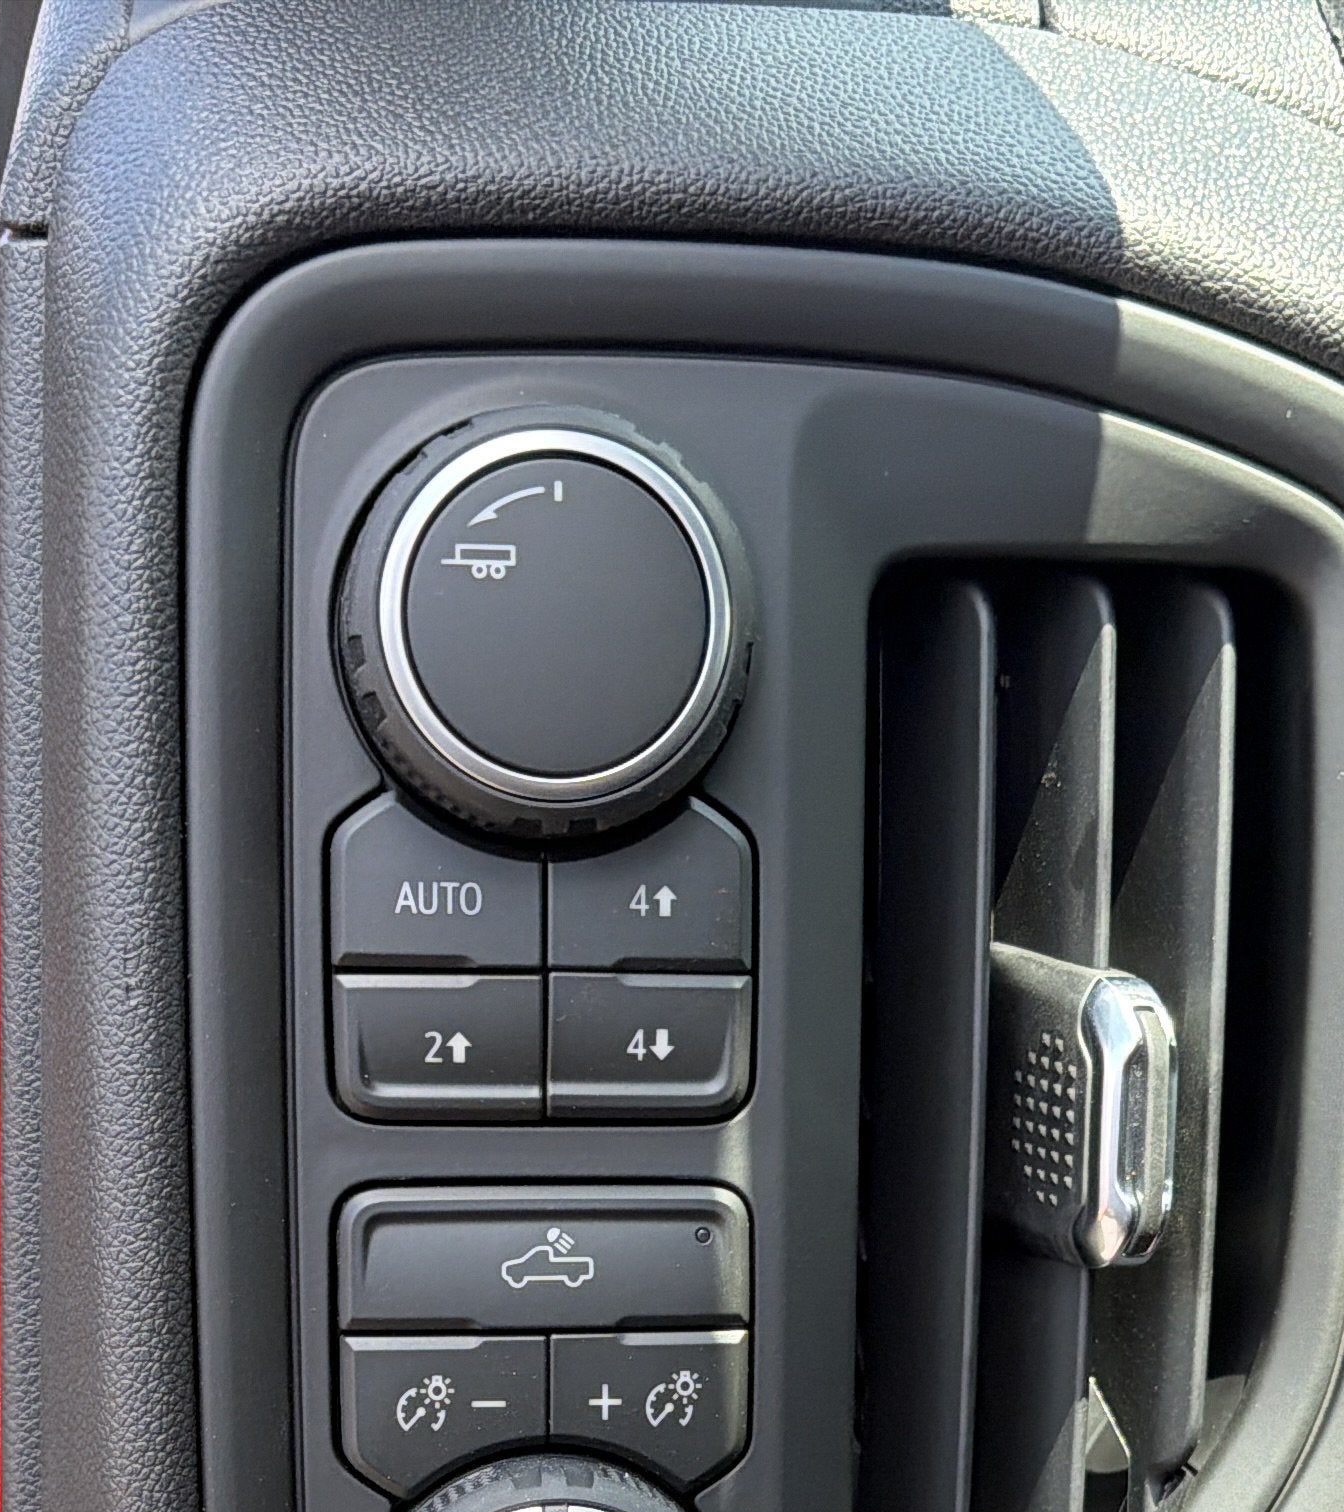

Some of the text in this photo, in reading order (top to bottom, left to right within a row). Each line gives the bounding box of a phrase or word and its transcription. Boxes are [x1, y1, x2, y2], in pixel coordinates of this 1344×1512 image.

[394, 880, 483, 917] AUTO
[628, 884, 650, 918] 4
[424, 1031, 444, 1064] 2
[626, 1029, 647, 1062] 4
